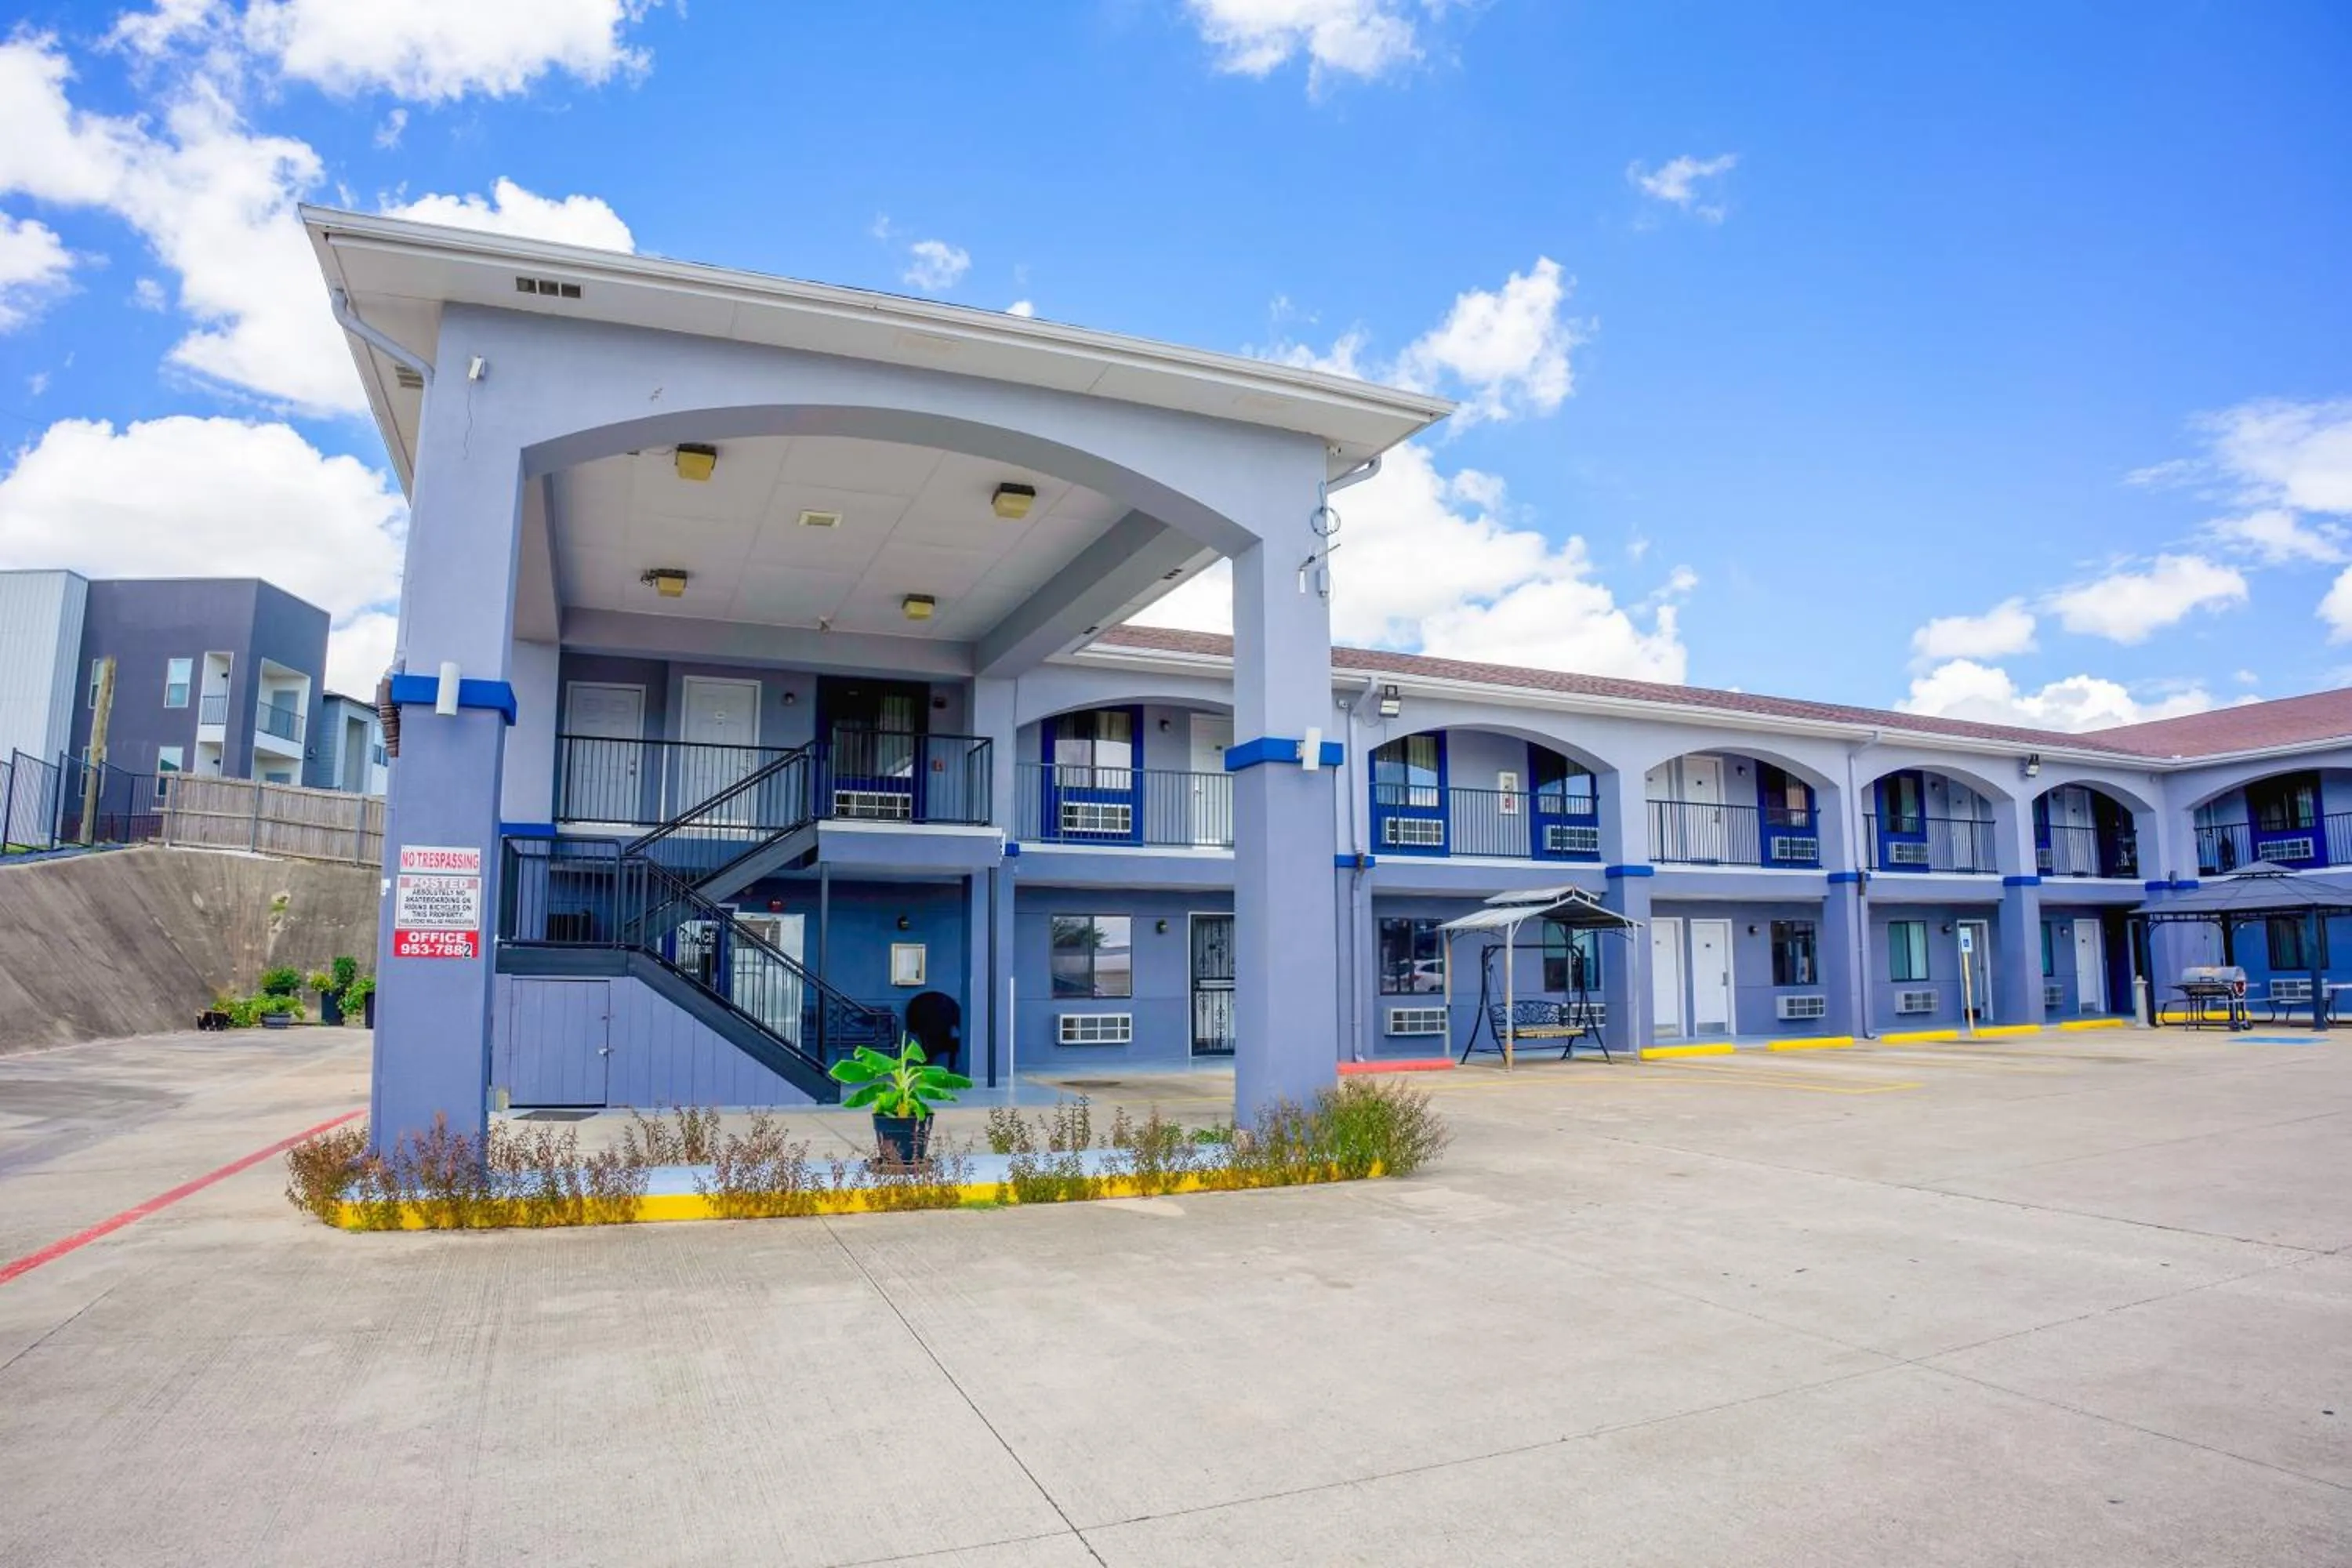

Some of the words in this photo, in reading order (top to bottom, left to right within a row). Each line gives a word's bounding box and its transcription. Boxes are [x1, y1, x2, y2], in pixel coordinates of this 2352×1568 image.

[401, 851, 415, 867] NO
[417, 851, 479, 869] TRESPASSING
[408, 931, 466, 943] OFFICE
[401, 943, 472, 957] 953-7882
